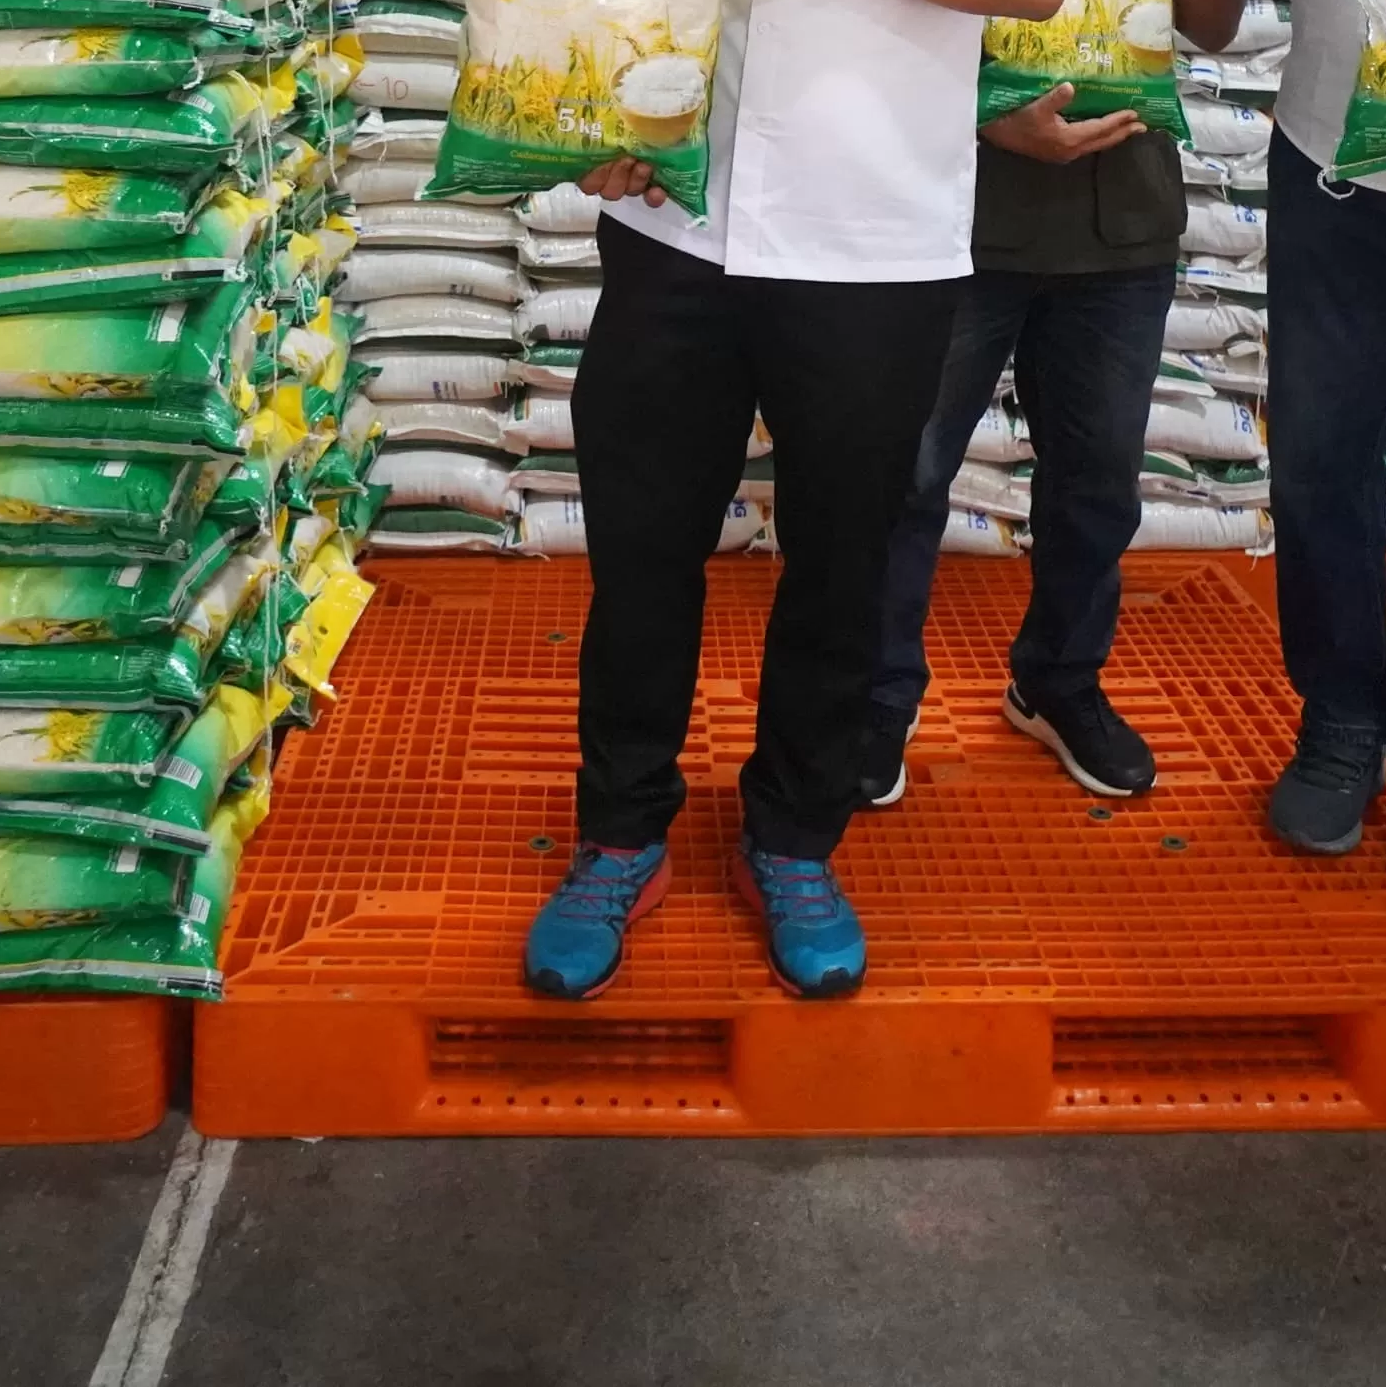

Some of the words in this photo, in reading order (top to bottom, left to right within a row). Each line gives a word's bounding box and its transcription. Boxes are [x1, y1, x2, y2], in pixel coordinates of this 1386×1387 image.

[1078, 42, 1093, 64] 5
[381, 75, 409, 102] 10
[559, 107, 576, 132] 5
[579, 117, 602, 139] kg
